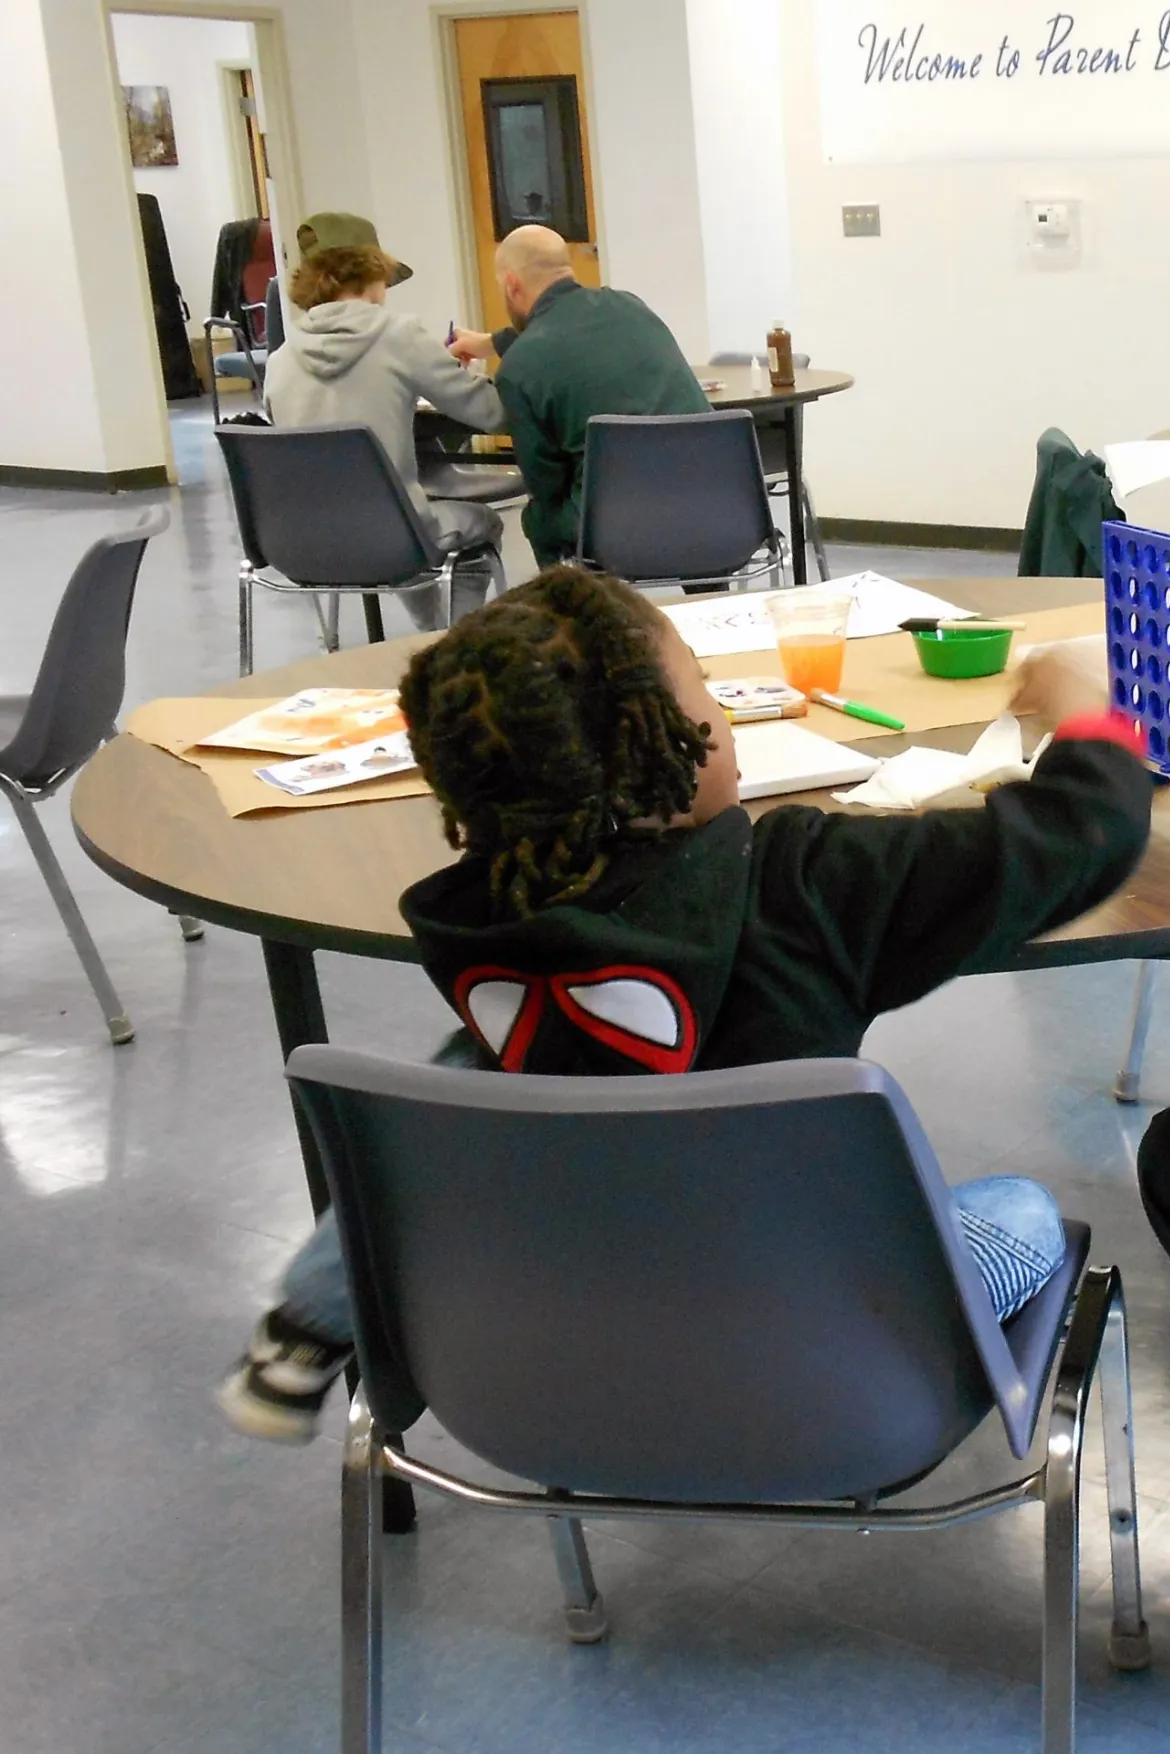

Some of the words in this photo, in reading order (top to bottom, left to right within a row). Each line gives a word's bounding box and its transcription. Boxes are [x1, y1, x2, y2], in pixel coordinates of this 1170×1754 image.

[858, 23, 983, 84] Welcome
[995, 35, 1020, 79] to
[1035, 12, 1141, 76] Parent
